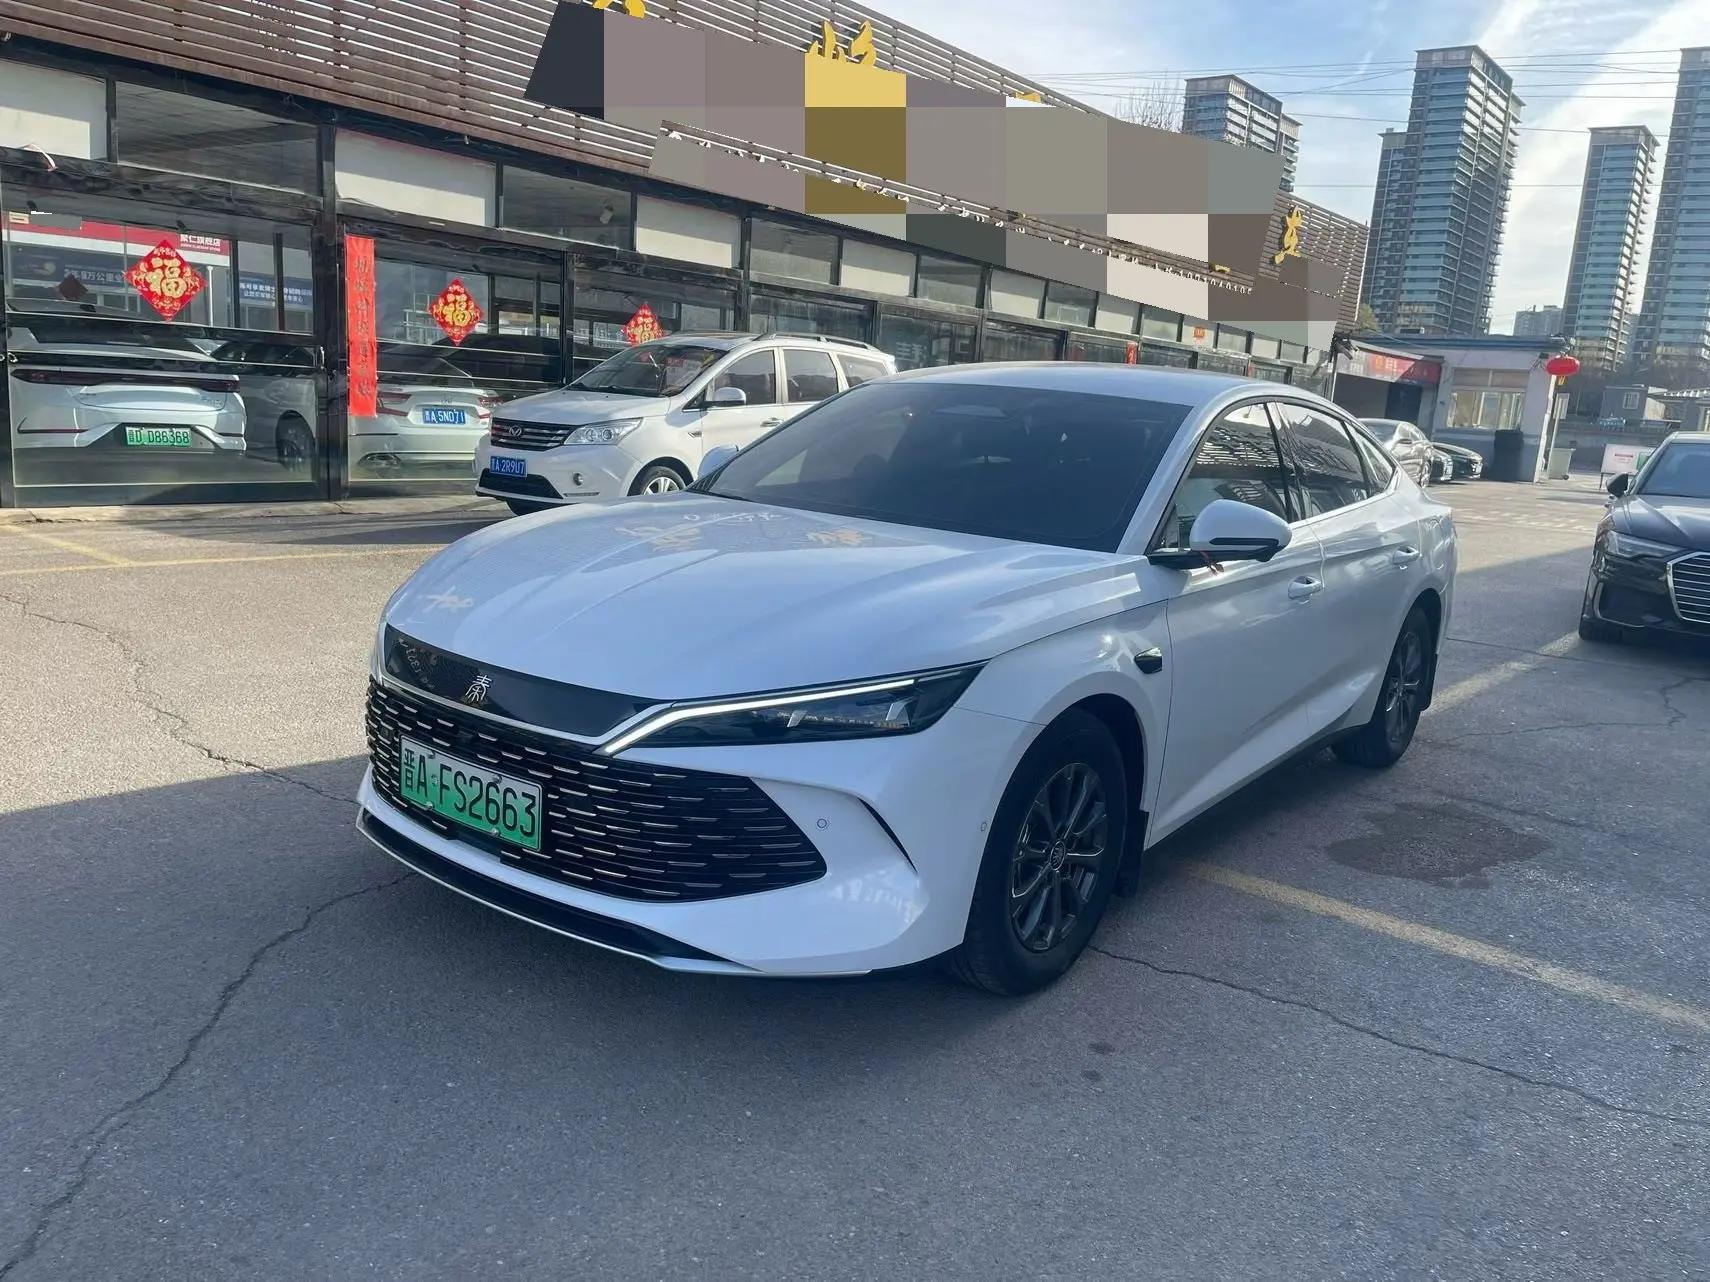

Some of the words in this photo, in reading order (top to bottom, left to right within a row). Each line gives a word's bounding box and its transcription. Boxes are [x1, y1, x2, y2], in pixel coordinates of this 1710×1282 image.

[145, 257, 188, 298] 福
[442, 293, 472, 328] 福
[465, 674, 493, 702] 秦
